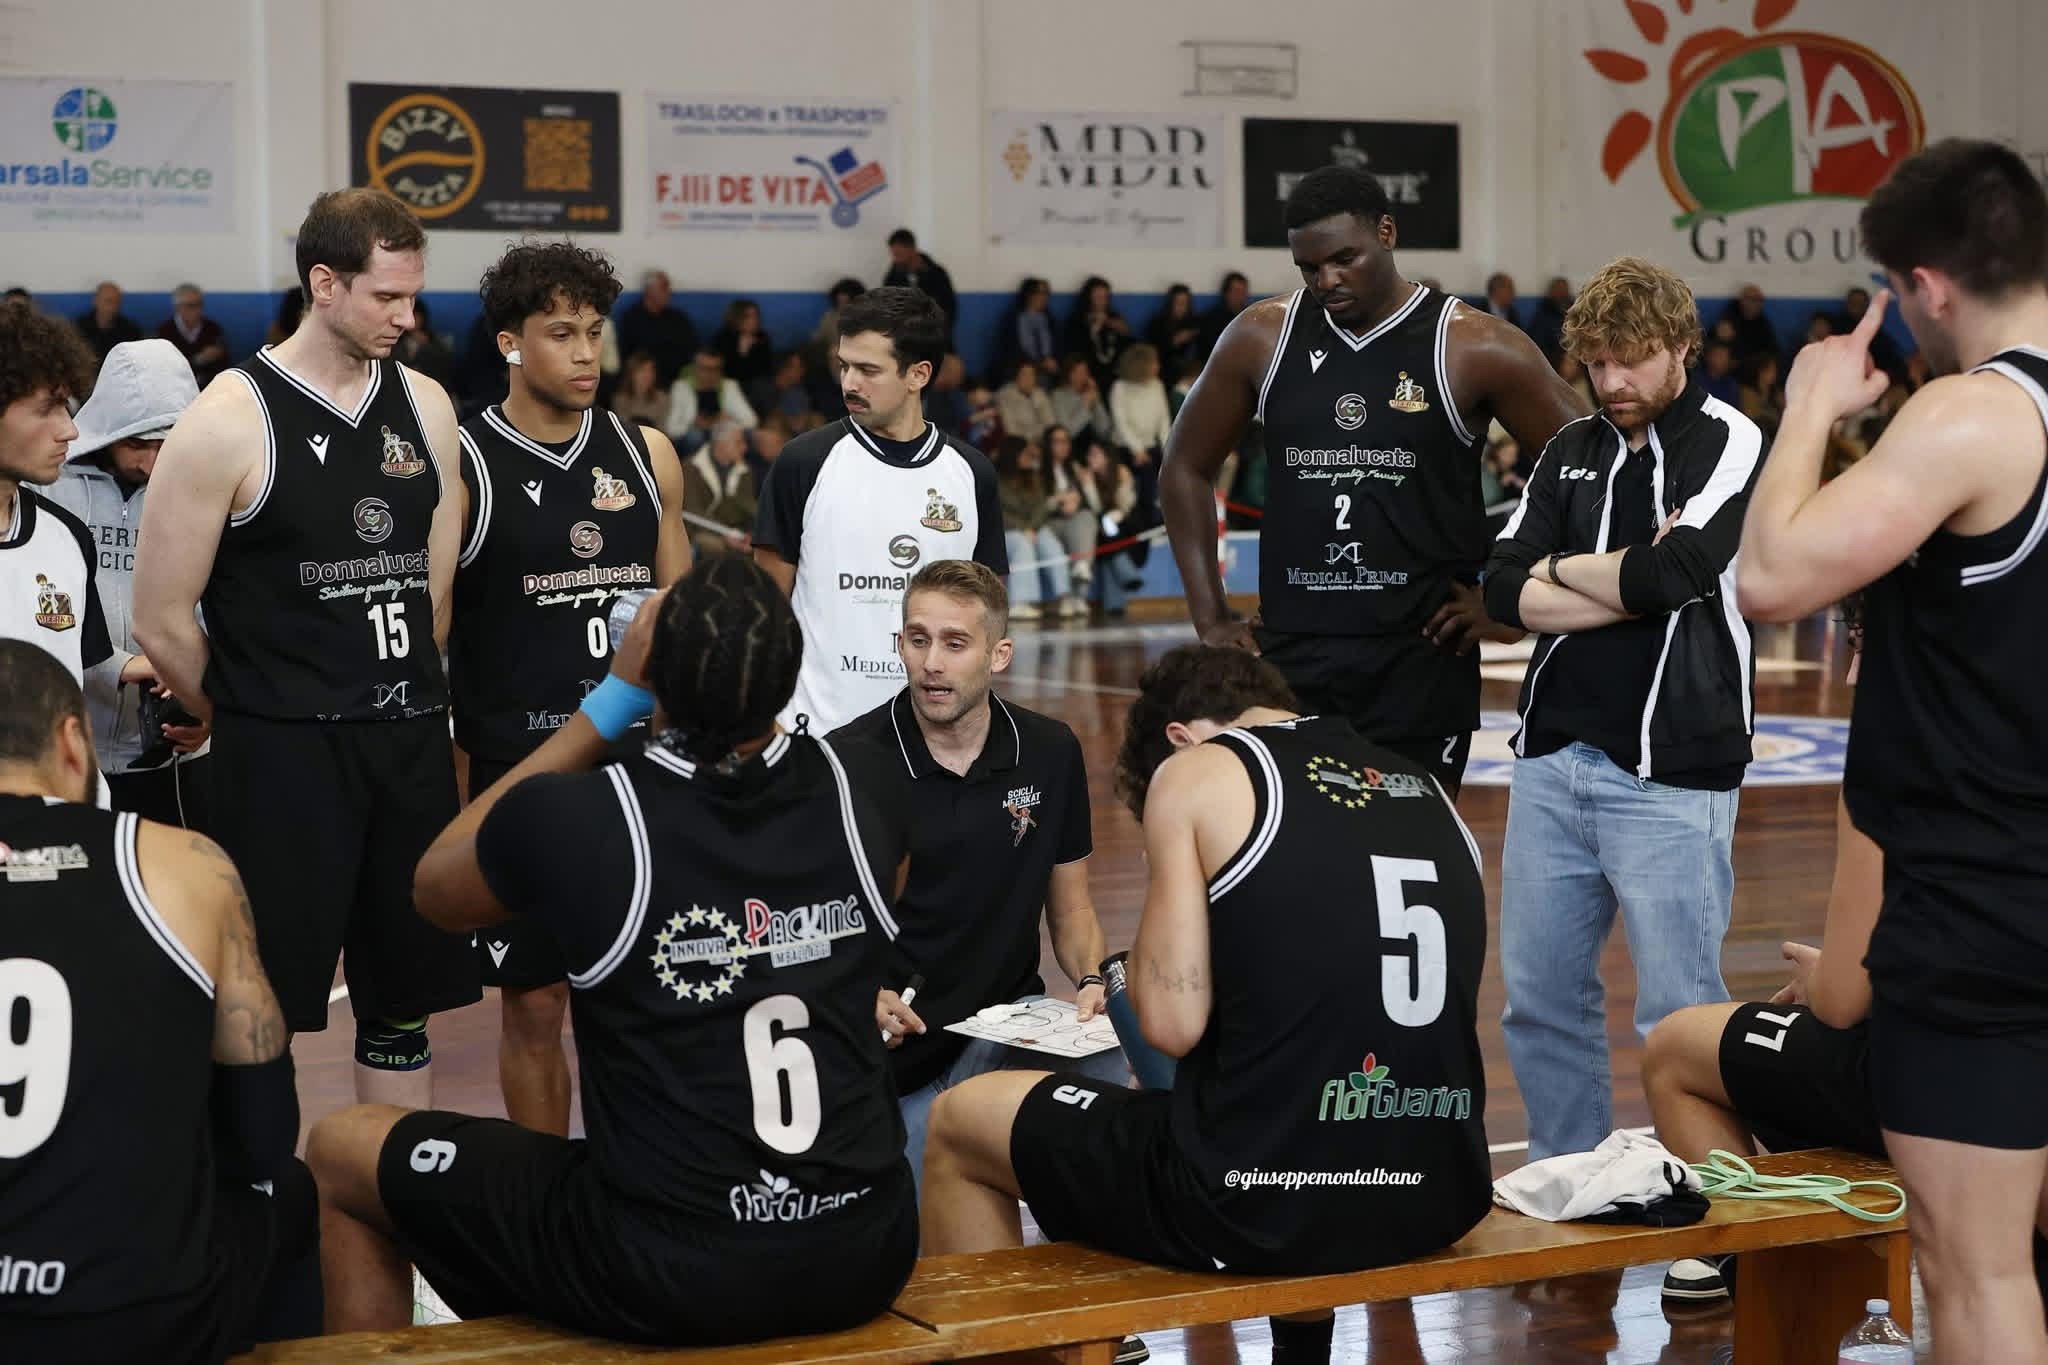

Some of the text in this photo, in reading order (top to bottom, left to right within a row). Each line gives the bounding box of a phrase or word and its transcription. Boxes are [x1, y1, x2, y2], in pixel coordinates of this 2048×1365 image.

[381, 107, 468, 151] BIZZY
[658, 103, 761, 121] TRASLOCHI
[785, 105, 887, 124] TRASPORTI
[1037, 122, 1214, 190] MDR
[718, 175, 753, 204] DE
[761, 175, 833, 205] VITA
[1691, 216, 1858, 264] GROU
[1286, 445, 1416, 467] Donnalucata
[1330, 468, 1366, 487] quality
[1334, 494, 1351, 531] 2
[300, 549, 428, 586] Donnalucat
[523, 562, 650, 594] Donnalucata
[839, 572, 911, 590] Donnal
[1287, 566, 1408, 585] MEDICAL PRIME
[367, 602, 410, 660] 15
[587, 616, 608, 658] 0
[840, 655, 904, 673] MEDICA
[1002, 792, 1041, 808] MEERKAT
[1008, 784, 1033, 799] SCICLI
[672, 939, 727, 959] INNOVA
[1370, 854, 1448, 1027] 5
[1744, 1011, 1801, 1052] 77
[0, 957, 72, 1158] 9
[367, 1047, 430, 1065] GIBAU
[743, 994, 821, 1154] 6
[1052, 1085, 1099, 1110] 5
[410, 1138, 457, 1173] 6
